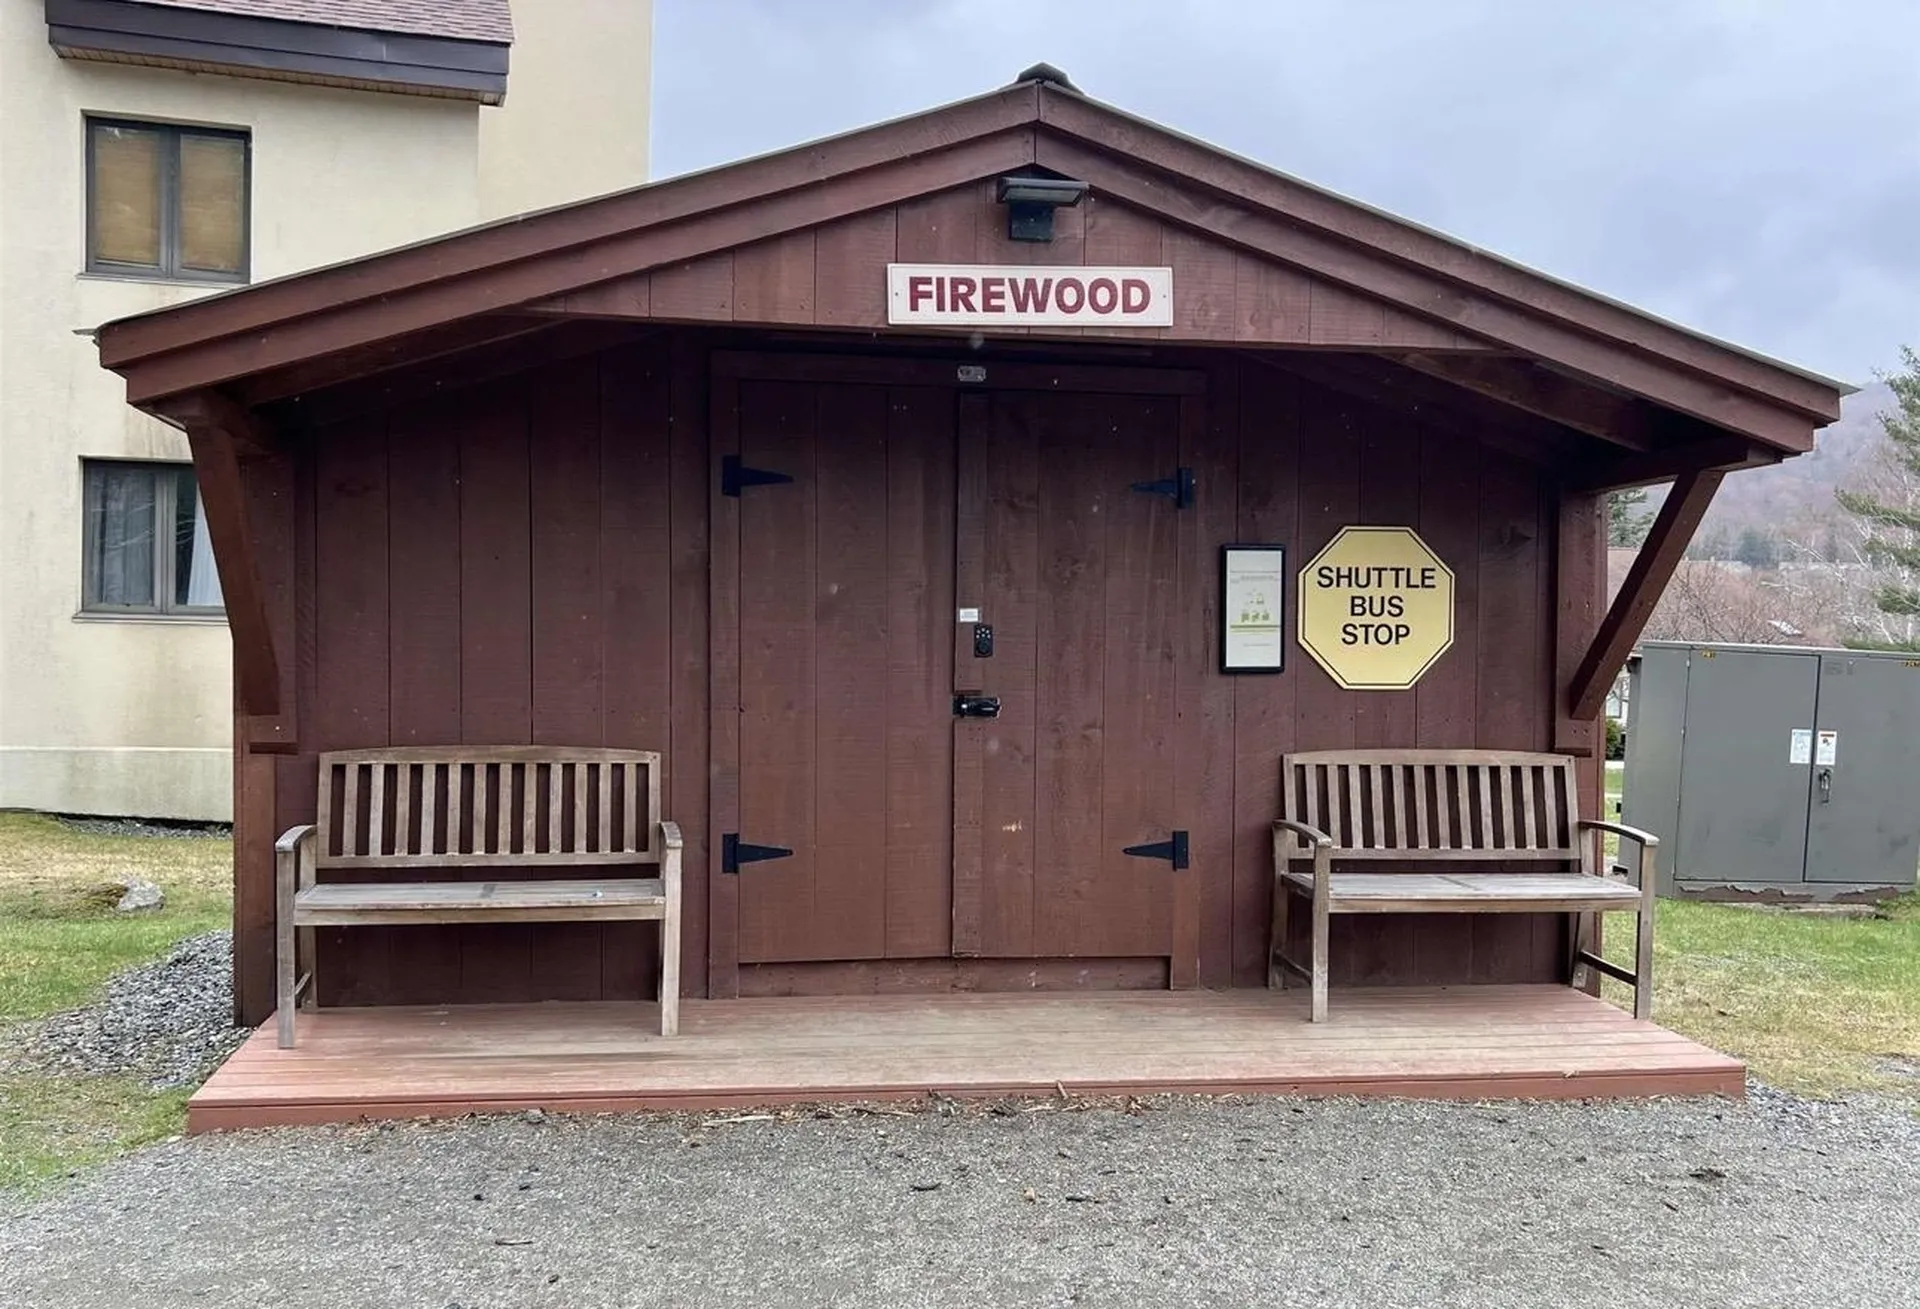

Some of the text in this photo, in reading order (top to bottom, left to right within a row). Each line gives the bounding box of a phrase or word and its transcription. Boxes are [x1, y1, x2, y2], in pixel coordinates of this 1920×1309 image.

[908, 276, 1151, 314] FIREWOOD
[1317, 566, 1436, 588] SHUTTLE
[1350, 596, 1404, 617] BUS
[1341, 623, 1411, 645] STOP
